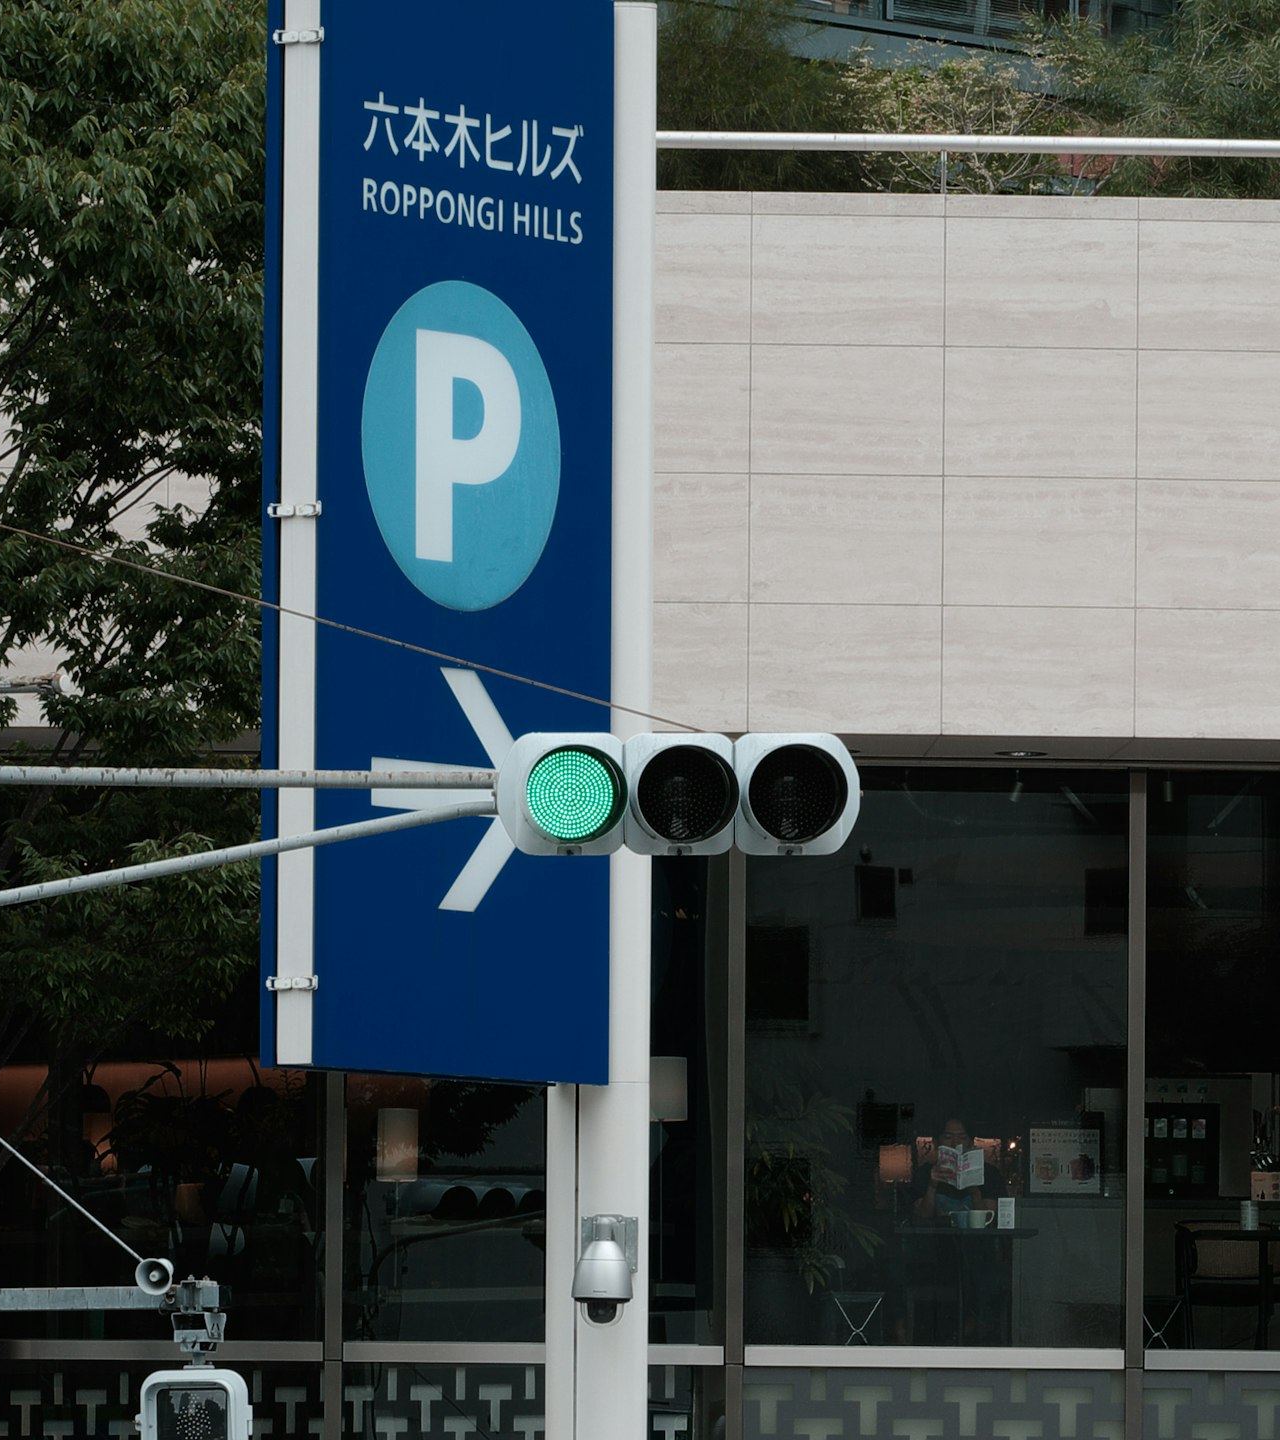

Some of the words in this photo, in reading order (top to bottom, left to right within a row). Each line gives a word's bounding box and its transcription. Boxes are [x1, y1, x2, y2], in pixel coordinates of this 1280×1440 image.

[363, 90, 584, 184] 六本木ヒルズ
[363, 177, 503, 232] ROPPONGI
[514, 201, 583, 244] HILLS
[415, 329, 522, 562] P
